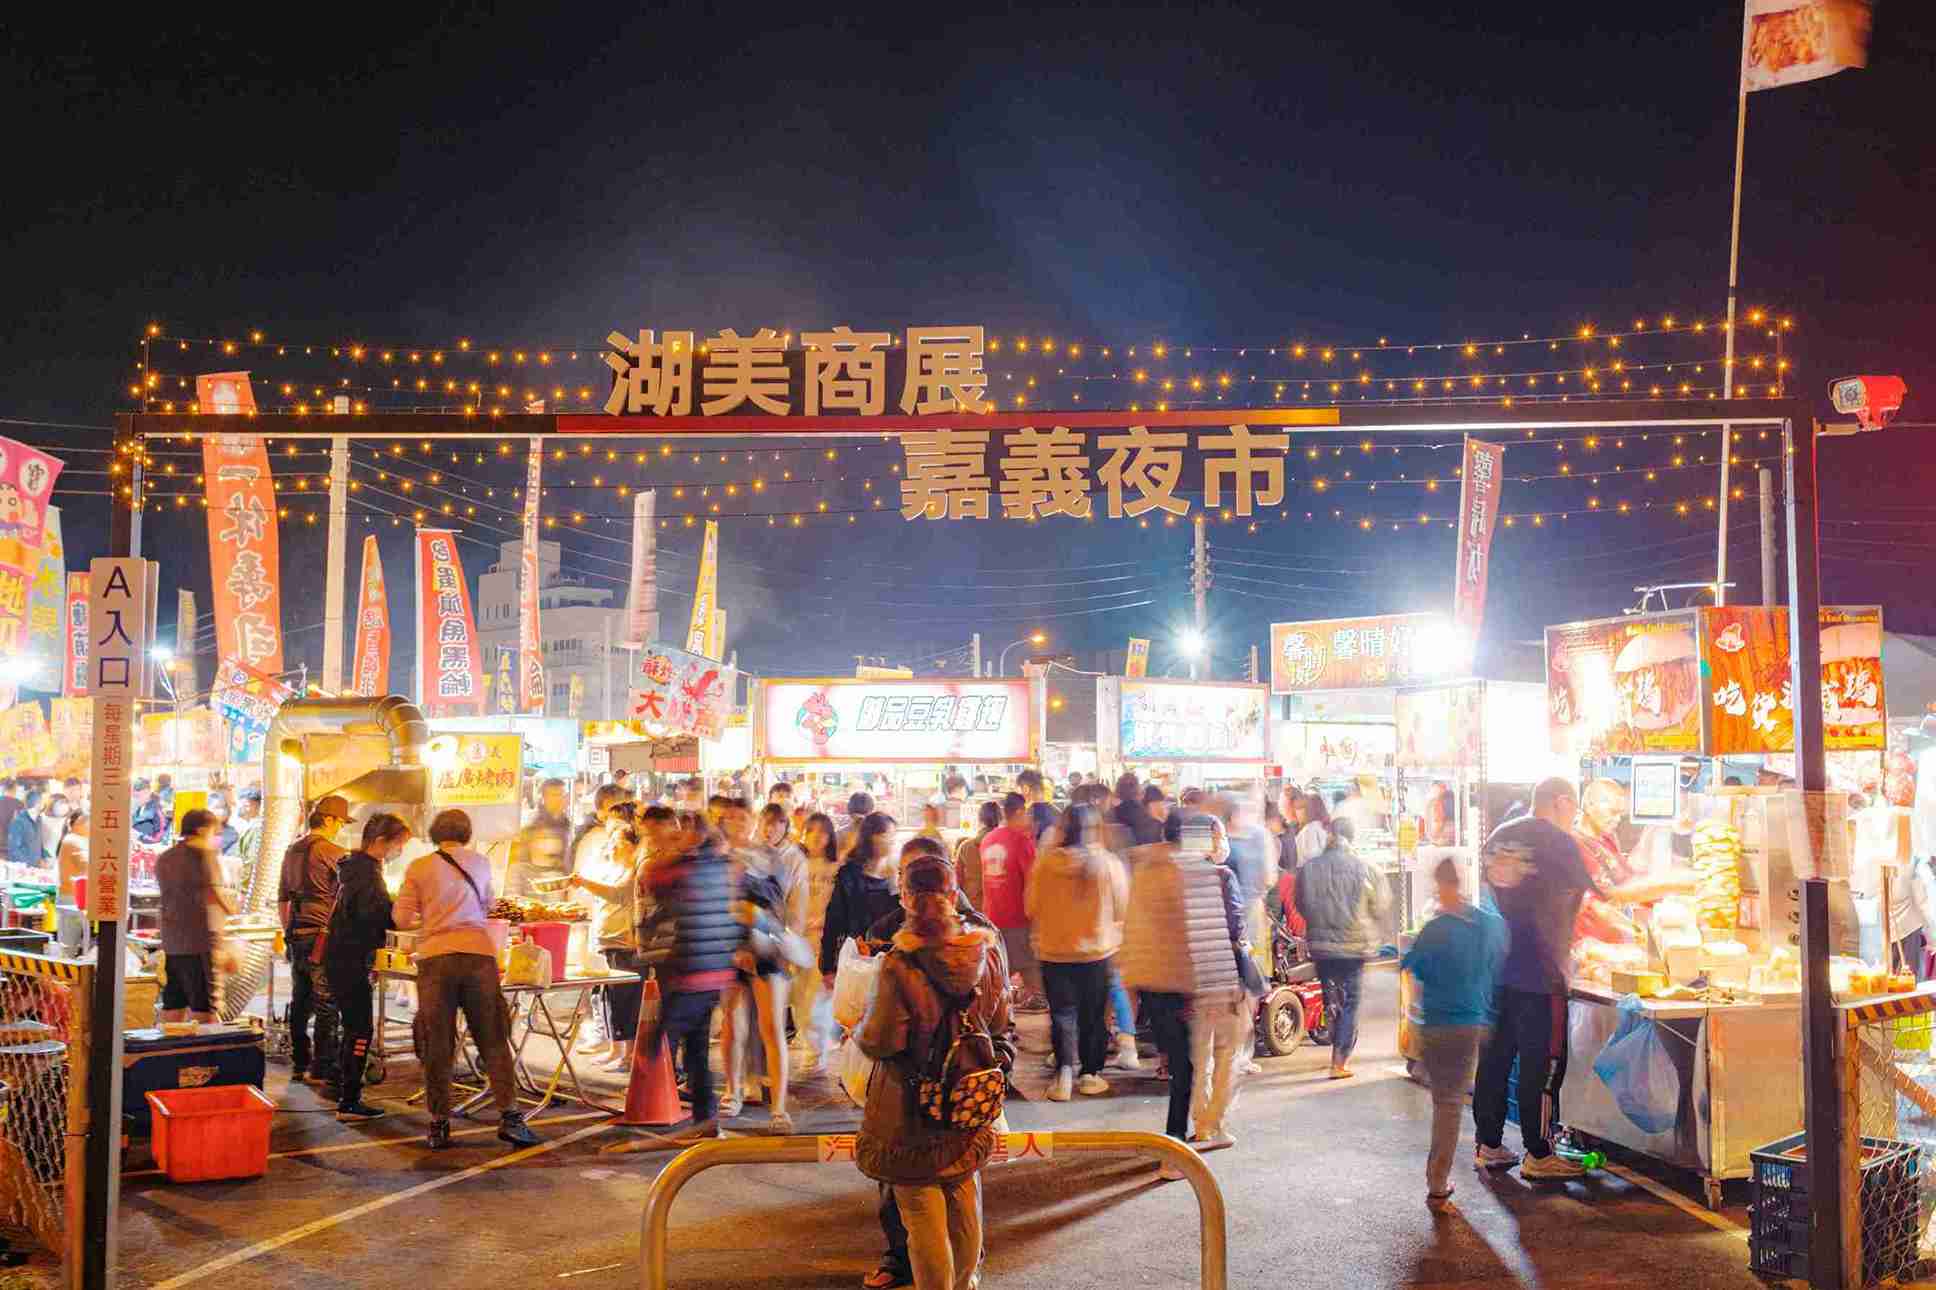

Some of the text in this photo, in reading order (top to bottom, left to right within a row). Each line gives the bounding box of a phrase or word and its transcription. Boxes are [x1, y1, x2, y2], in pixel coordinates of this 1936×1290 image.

[603, 325, 989, 417] 湖美商展
[900, 425, 1290, 520] 嘉義夜市
[99, 565, 133, 689] A入口
